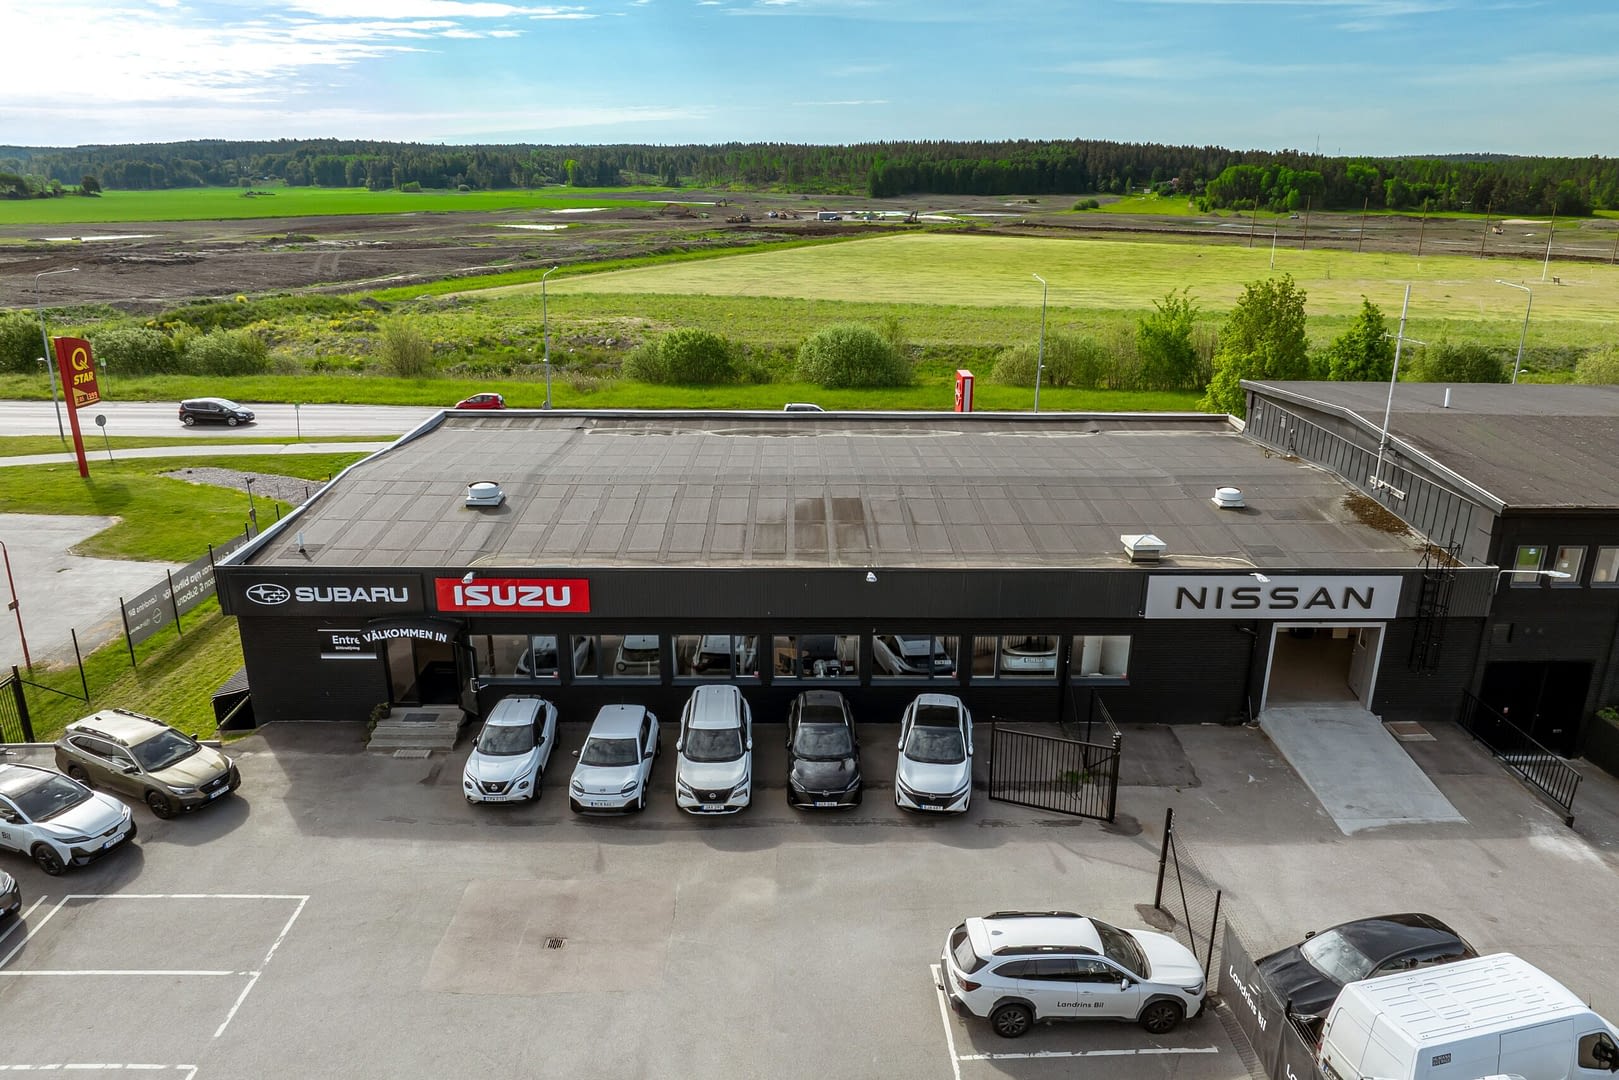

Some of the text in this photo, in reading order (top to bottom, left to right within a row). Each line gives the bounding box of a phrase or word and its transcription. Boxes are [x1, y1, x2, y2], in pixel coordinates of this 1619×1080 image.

[72, 347, 89, 371] Q
[73, 371, 94, 385] STAR
[295, 586, 409, 602] SUBARU
[453, 585, 571, 607] ISUZU
[1175, 586, 1375, 610] NISSAN
[362, 628, 448, 642] VÄLKOMMEN IN
[1229, 965, 1267, 1031] Landrins Bil
